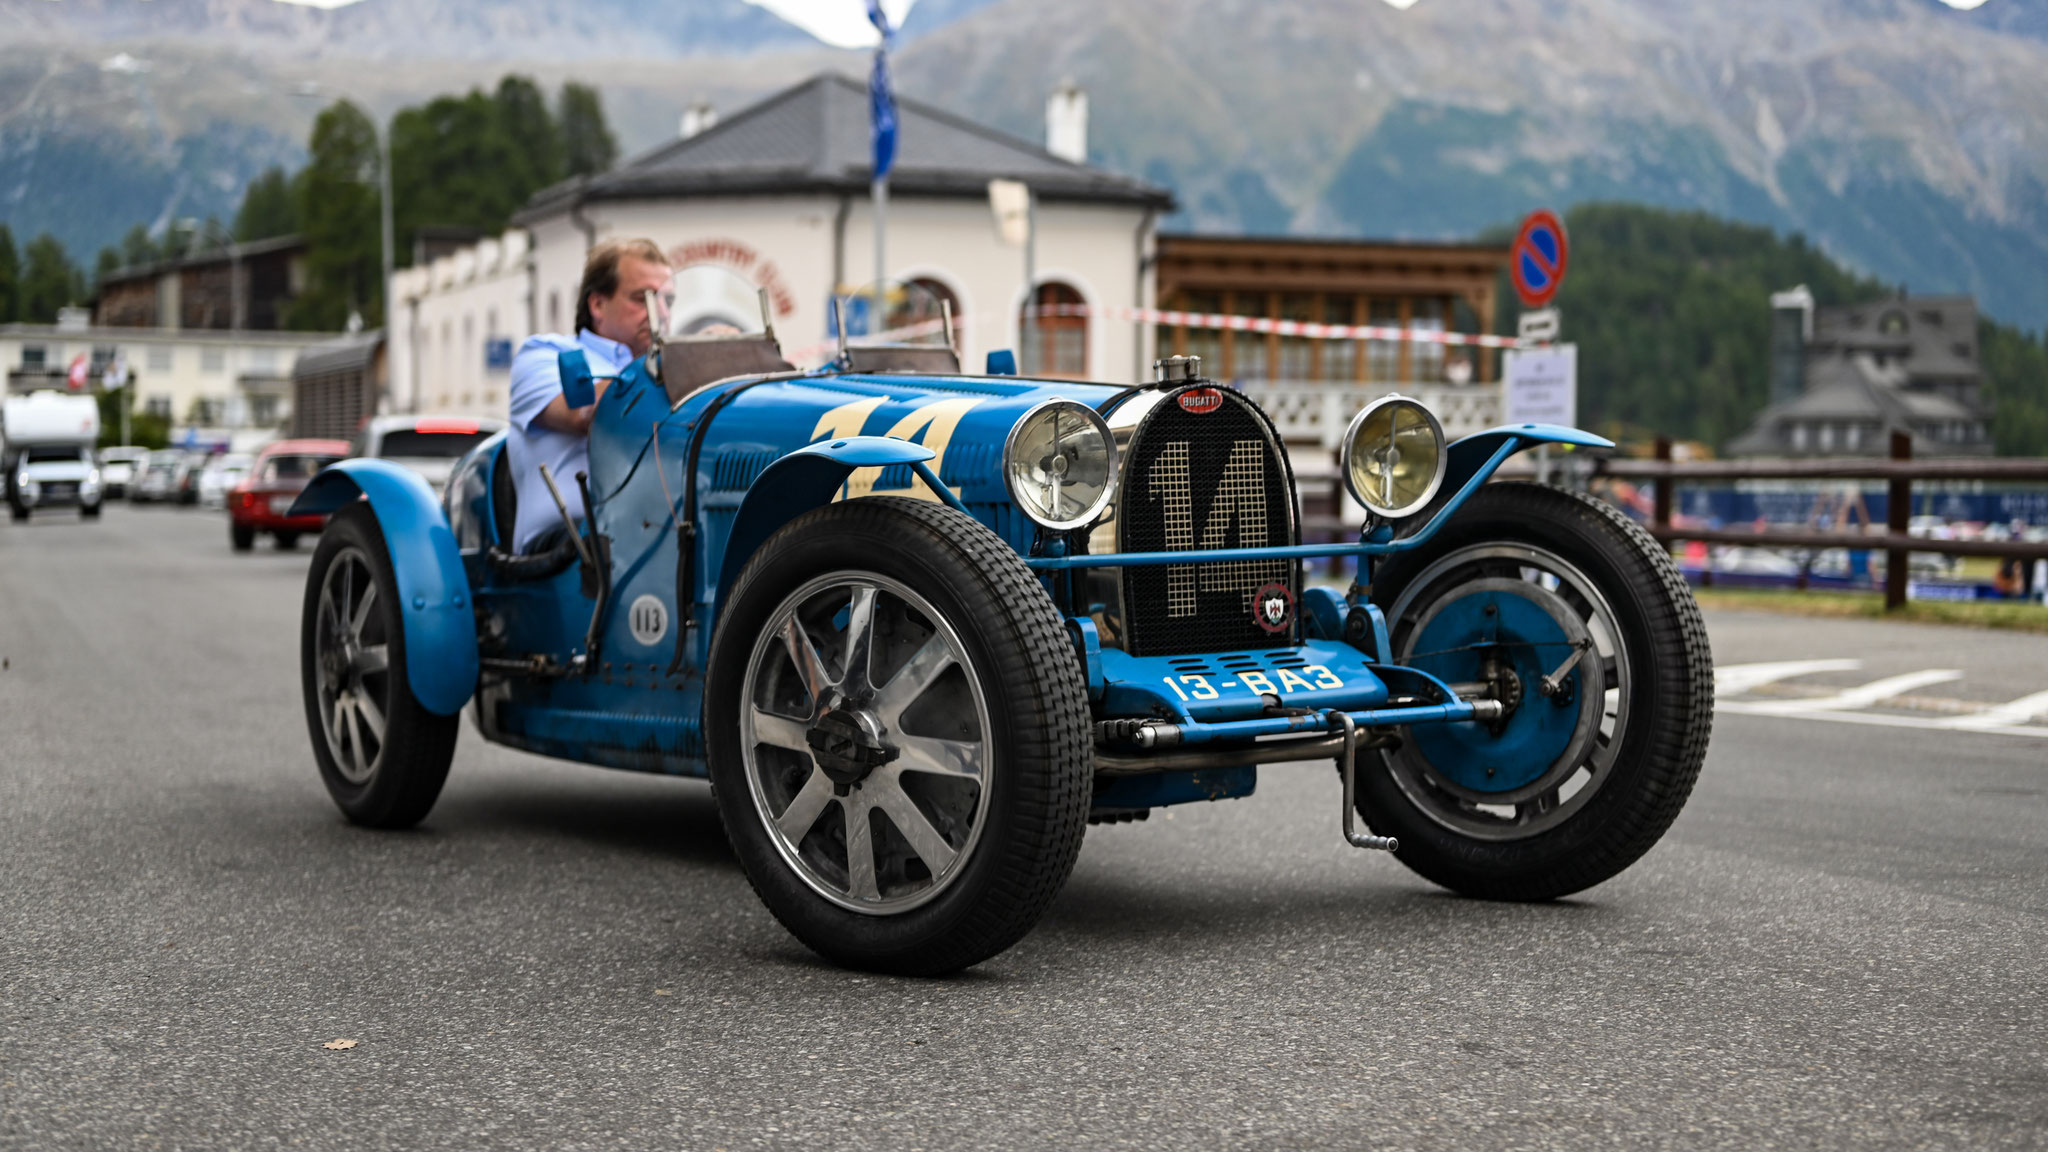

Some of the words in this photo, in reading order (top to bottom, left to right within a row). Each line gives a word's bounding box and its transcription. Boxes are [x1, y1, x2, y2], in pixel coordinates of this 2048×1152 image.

[1183, 395, 1219, 407] BUGATTI
[1148, 440, 1289, 618] 14
[636, 607, 661, 634] 113
